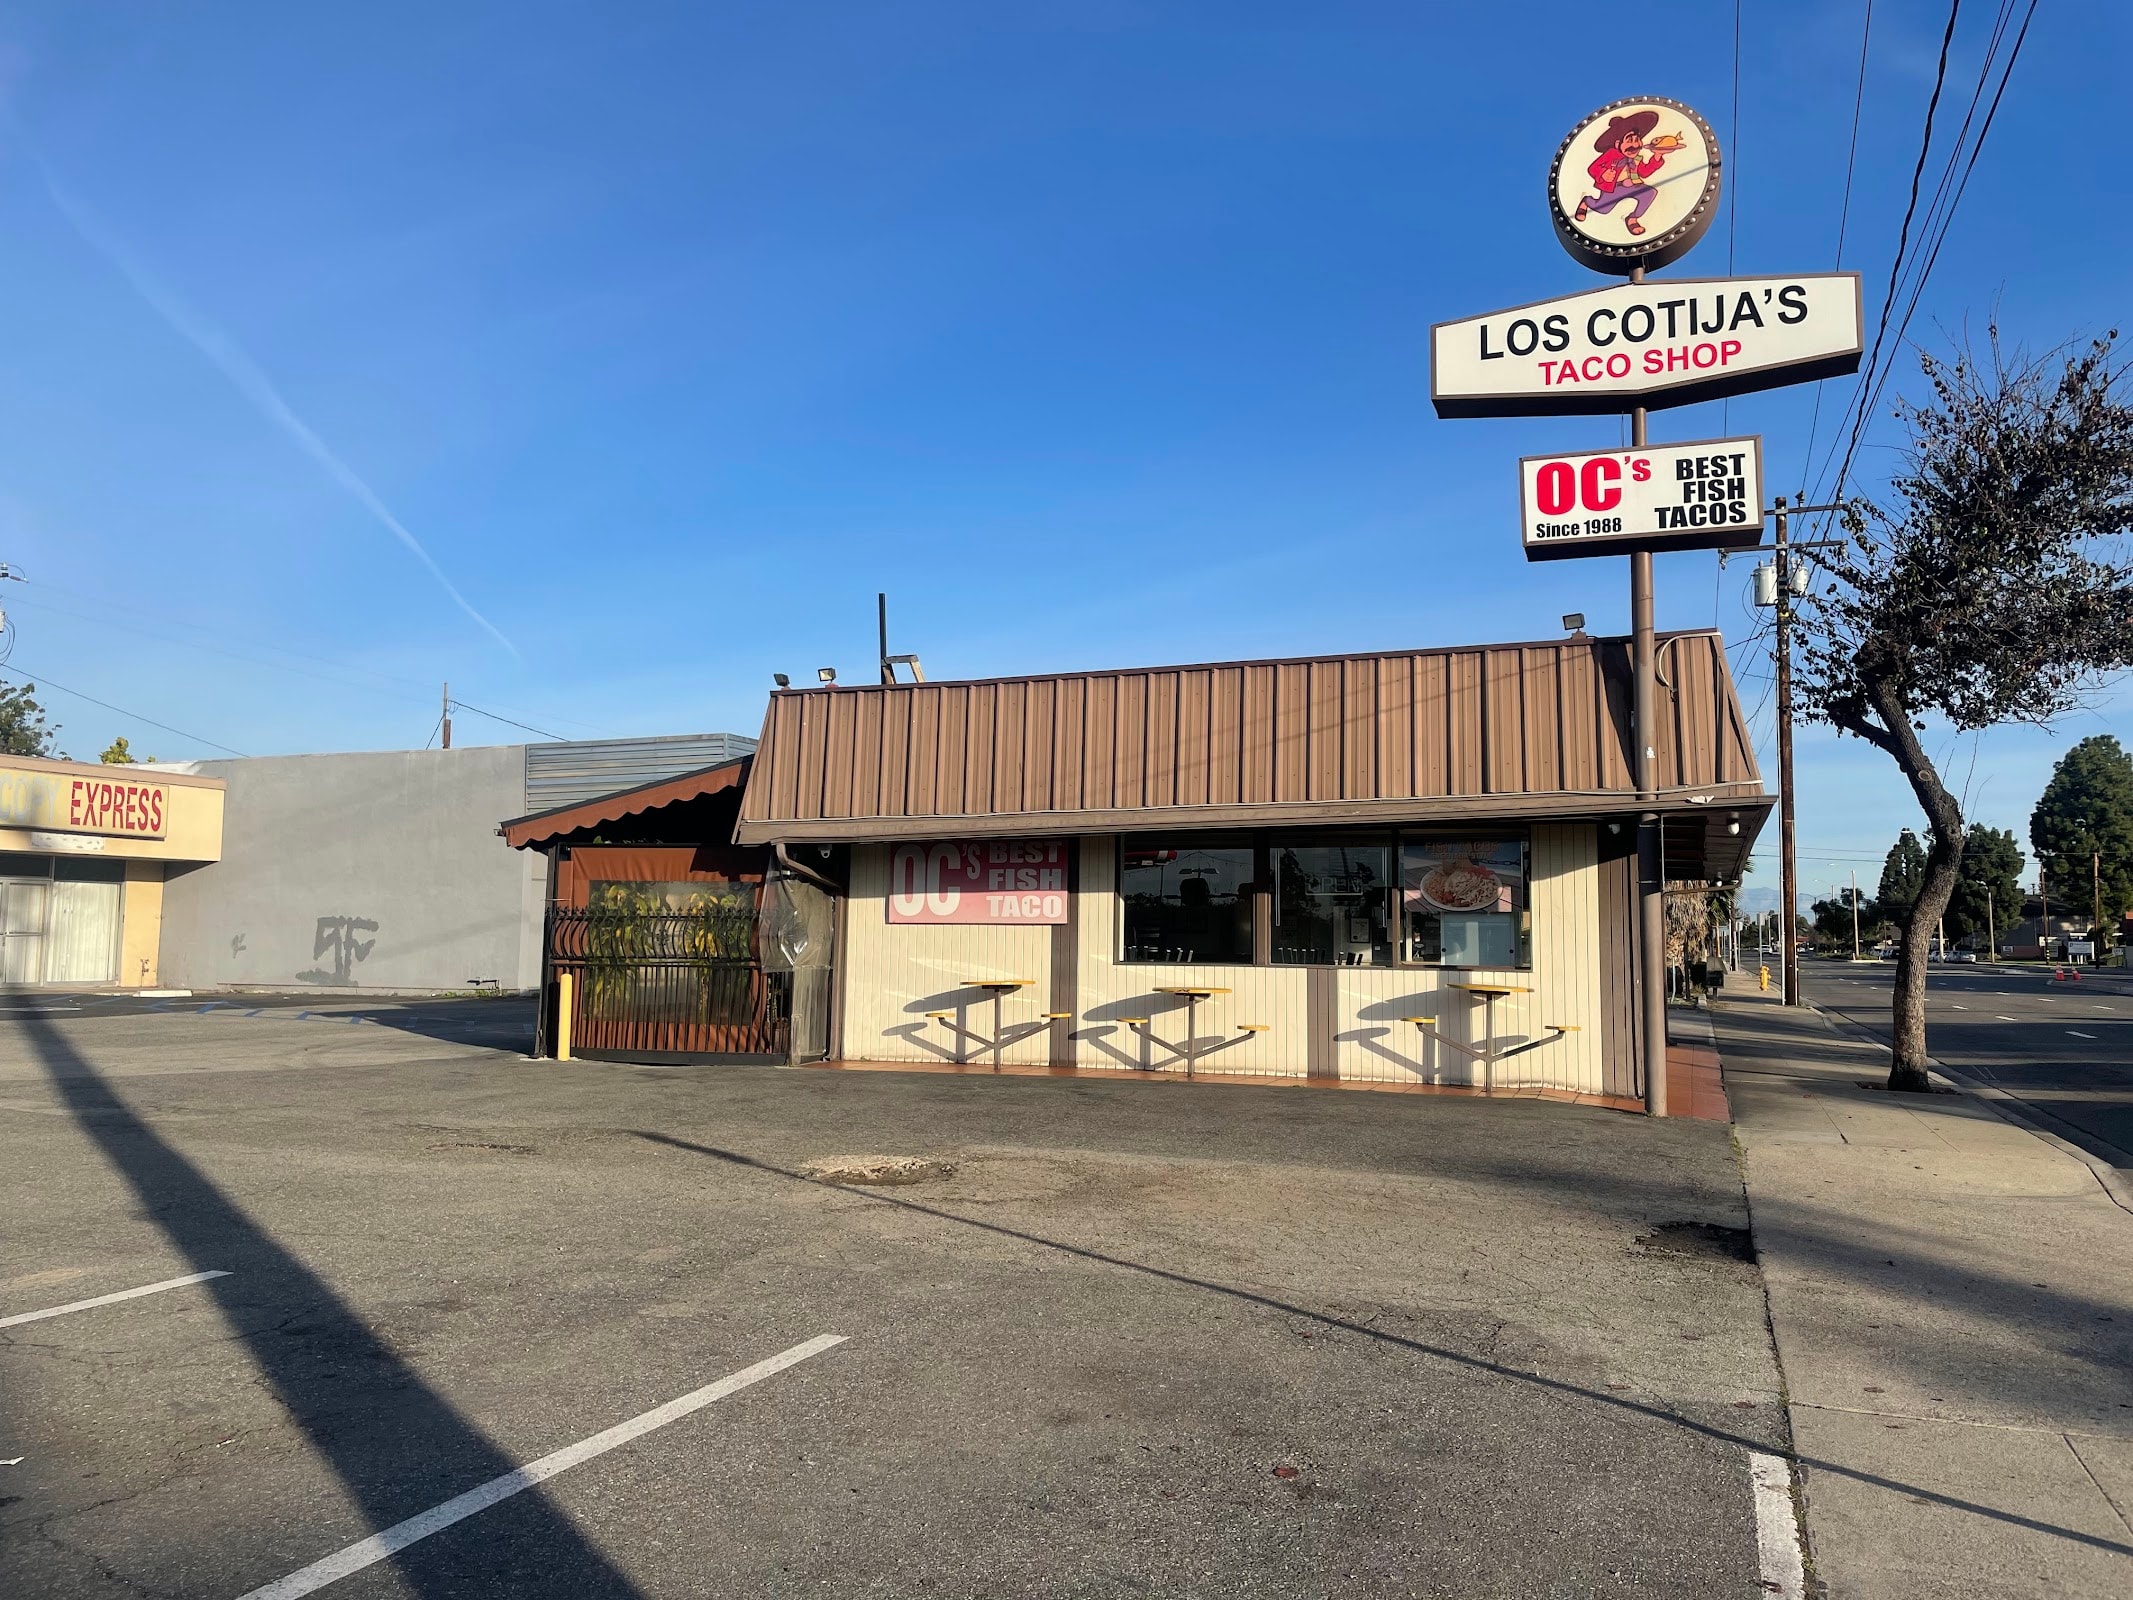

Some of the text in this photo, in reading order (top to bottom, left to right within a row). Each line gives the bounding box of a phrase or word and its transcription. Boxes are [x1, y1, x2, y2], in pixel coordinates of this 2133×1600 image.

[1480, 285, 1808, 361] LOS COTIJA'S
[1538, 340, 1742, 385] TACO SHOP
[1676, 453, 1746, 480] BEST
[1683, 478, 1746, 504] FISH
[1536, 517, 1622, 539] Since 1988
[1654, 501, 1747, 529] TACOS
[70, 781, 163, 832] EXPRESS
[988, 840, 1063, 864] BEST
[988, 868, 1062, 891] FISH
[986, 895, 1062, 918] TACO
